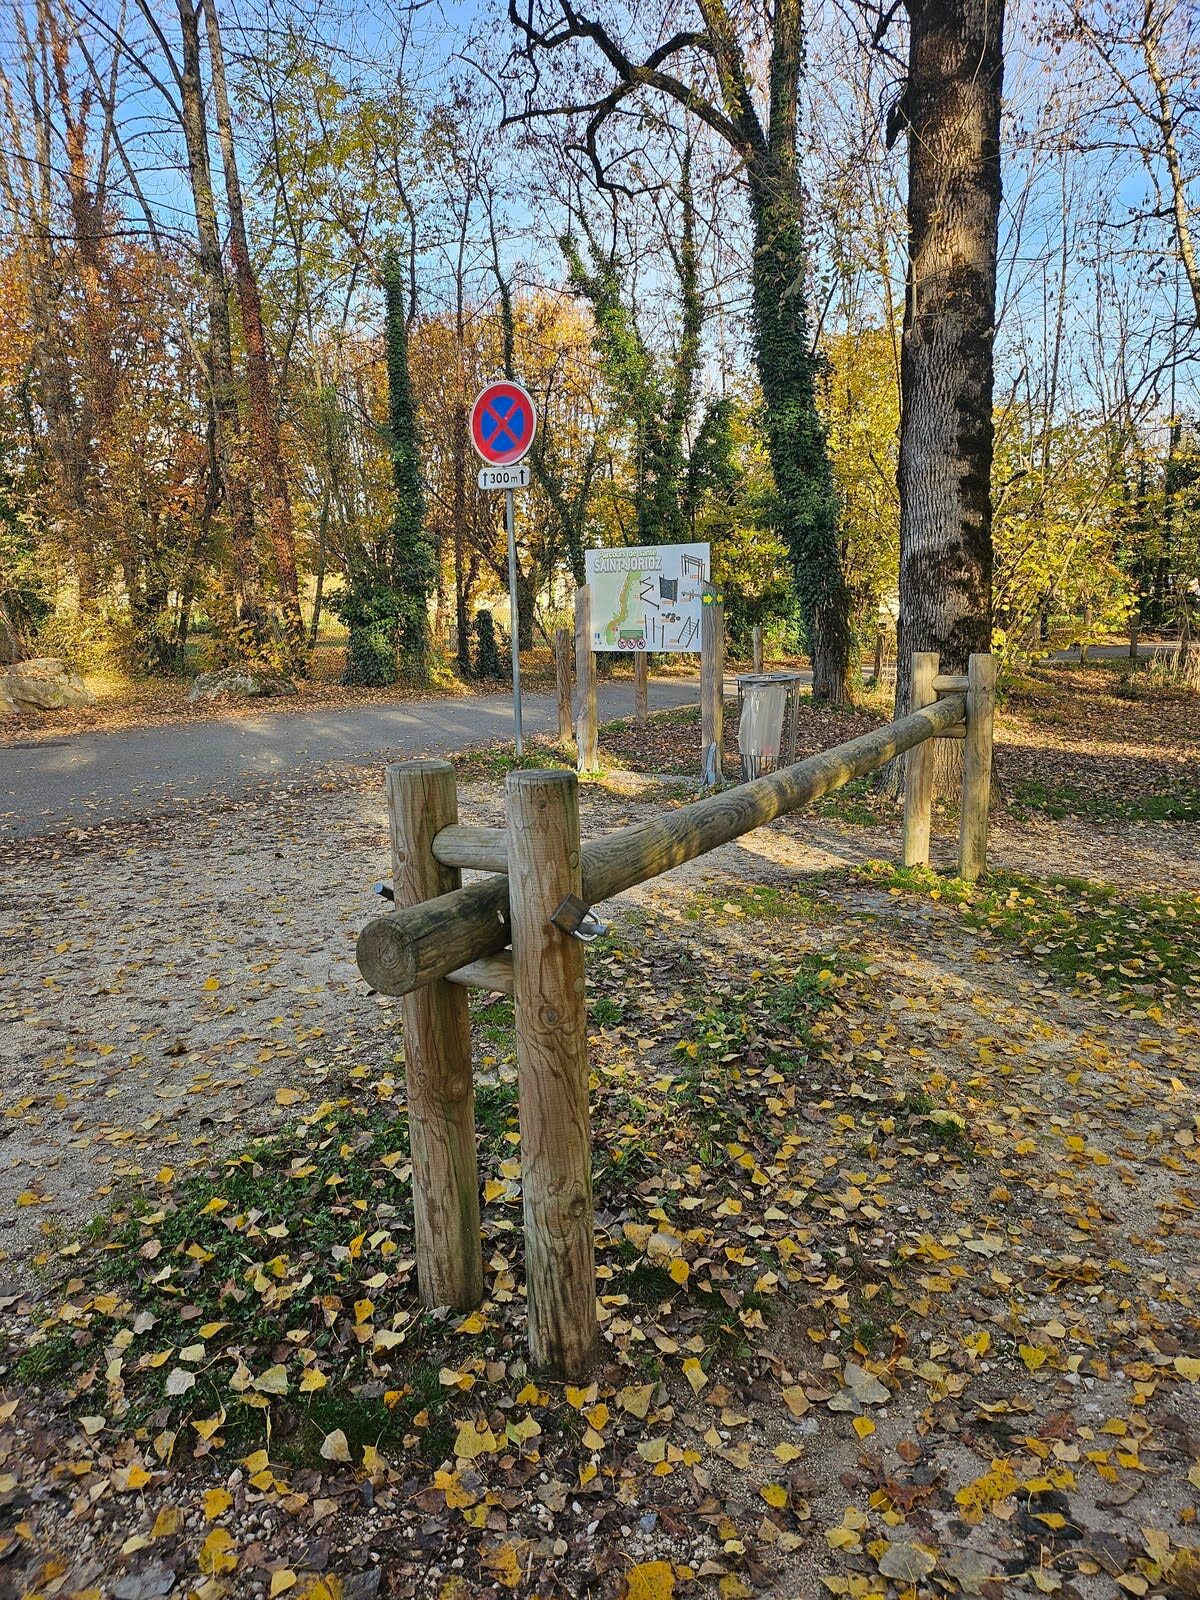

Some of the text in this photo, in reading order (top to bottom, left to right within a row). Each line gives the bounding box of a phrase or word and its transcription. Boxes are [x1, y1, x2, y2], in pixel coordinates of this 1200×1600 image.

[599, 548, 657, 560] Parcours de santé
[594, 557, 662, 573] SAINT-JORIOZ
